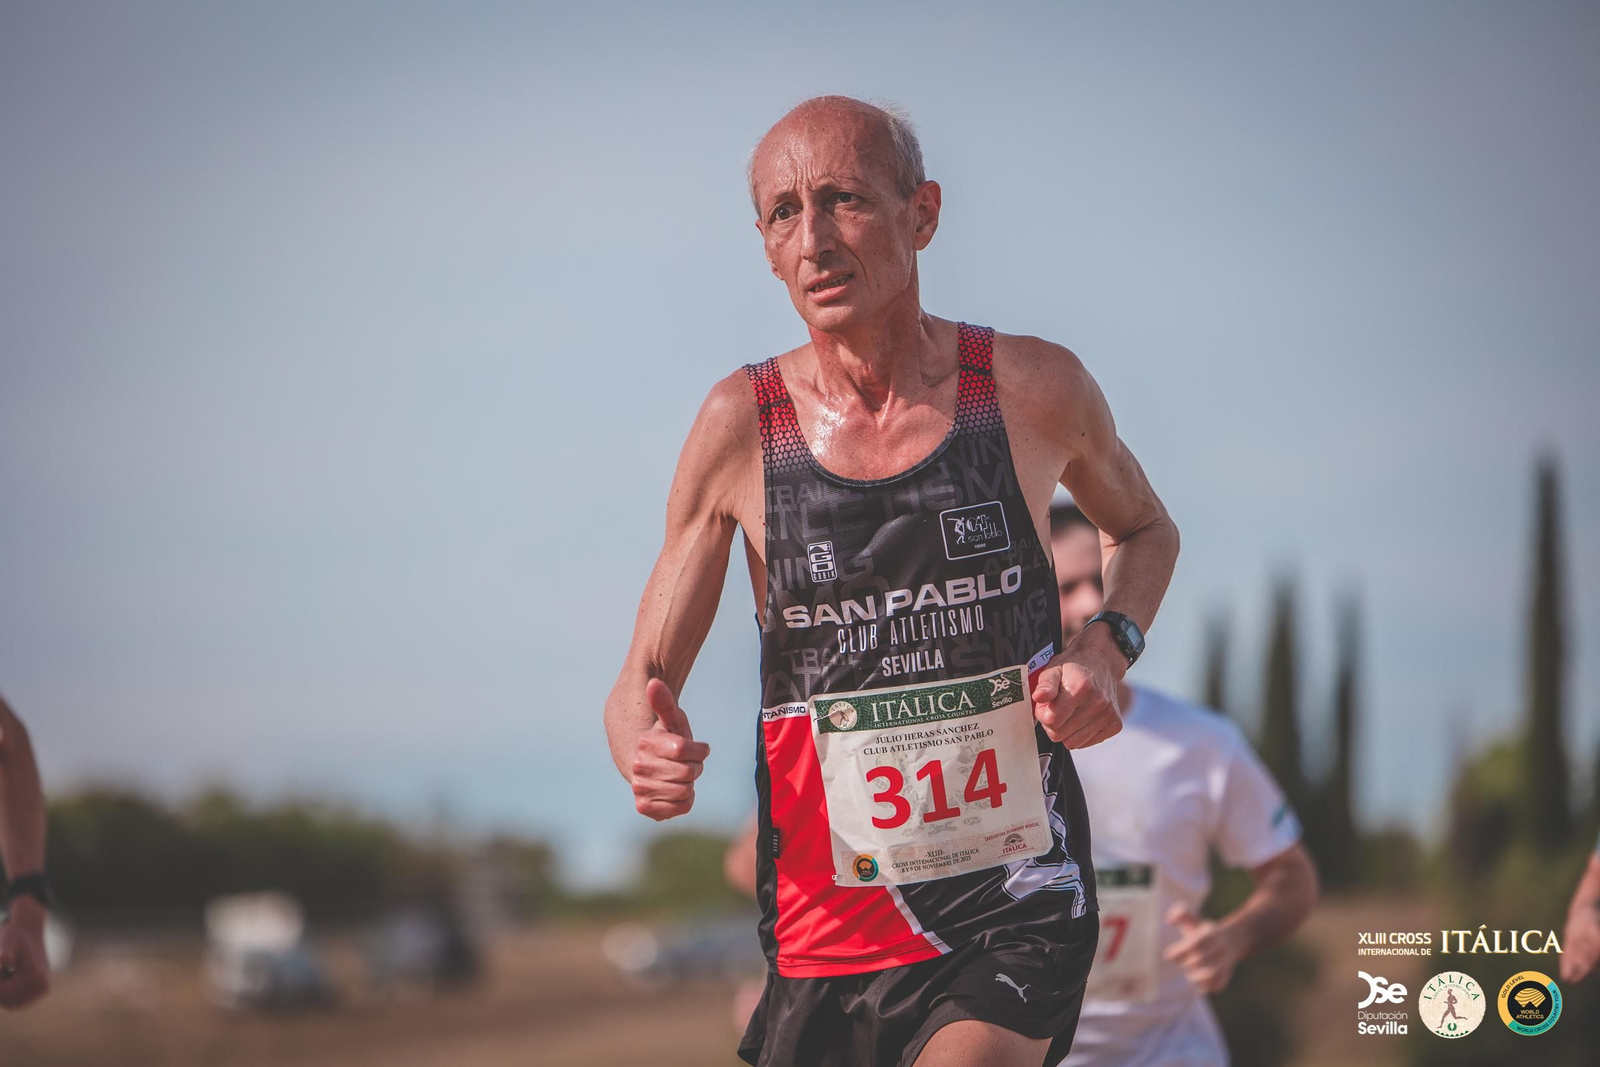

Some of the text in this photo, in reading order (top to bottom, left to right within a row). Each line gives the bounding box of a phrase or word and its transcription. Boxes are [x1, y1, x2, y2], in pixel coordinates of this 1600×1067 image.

[782, 595, 877, 629] SAN
[885, 565, 1022, 617] PABLO
[837, 604, 985, 654] CLUB ATLETISMO
[882, 648, 945, 677] SEVILLA
[870, 690, 976, 722] ITÁLICA
[992, 696, 1013, 708] Sevilla
[874, 709, 977, 728] INTERNATIONAL CROSS COUNTRY
[863, 728, 994, 756] CLUB ATLETISMO SAN PABLO
[875, 734, 902, 745] JULIO
[904, 730, 935, 742] HERAS
[865, 748, 1008, 830] 314
[892, 861, 909, 869] CROSS
[909, 854, 952, 866] INTERNACIONAL
[922, 860, 952, 871] NOVIEMBRE
